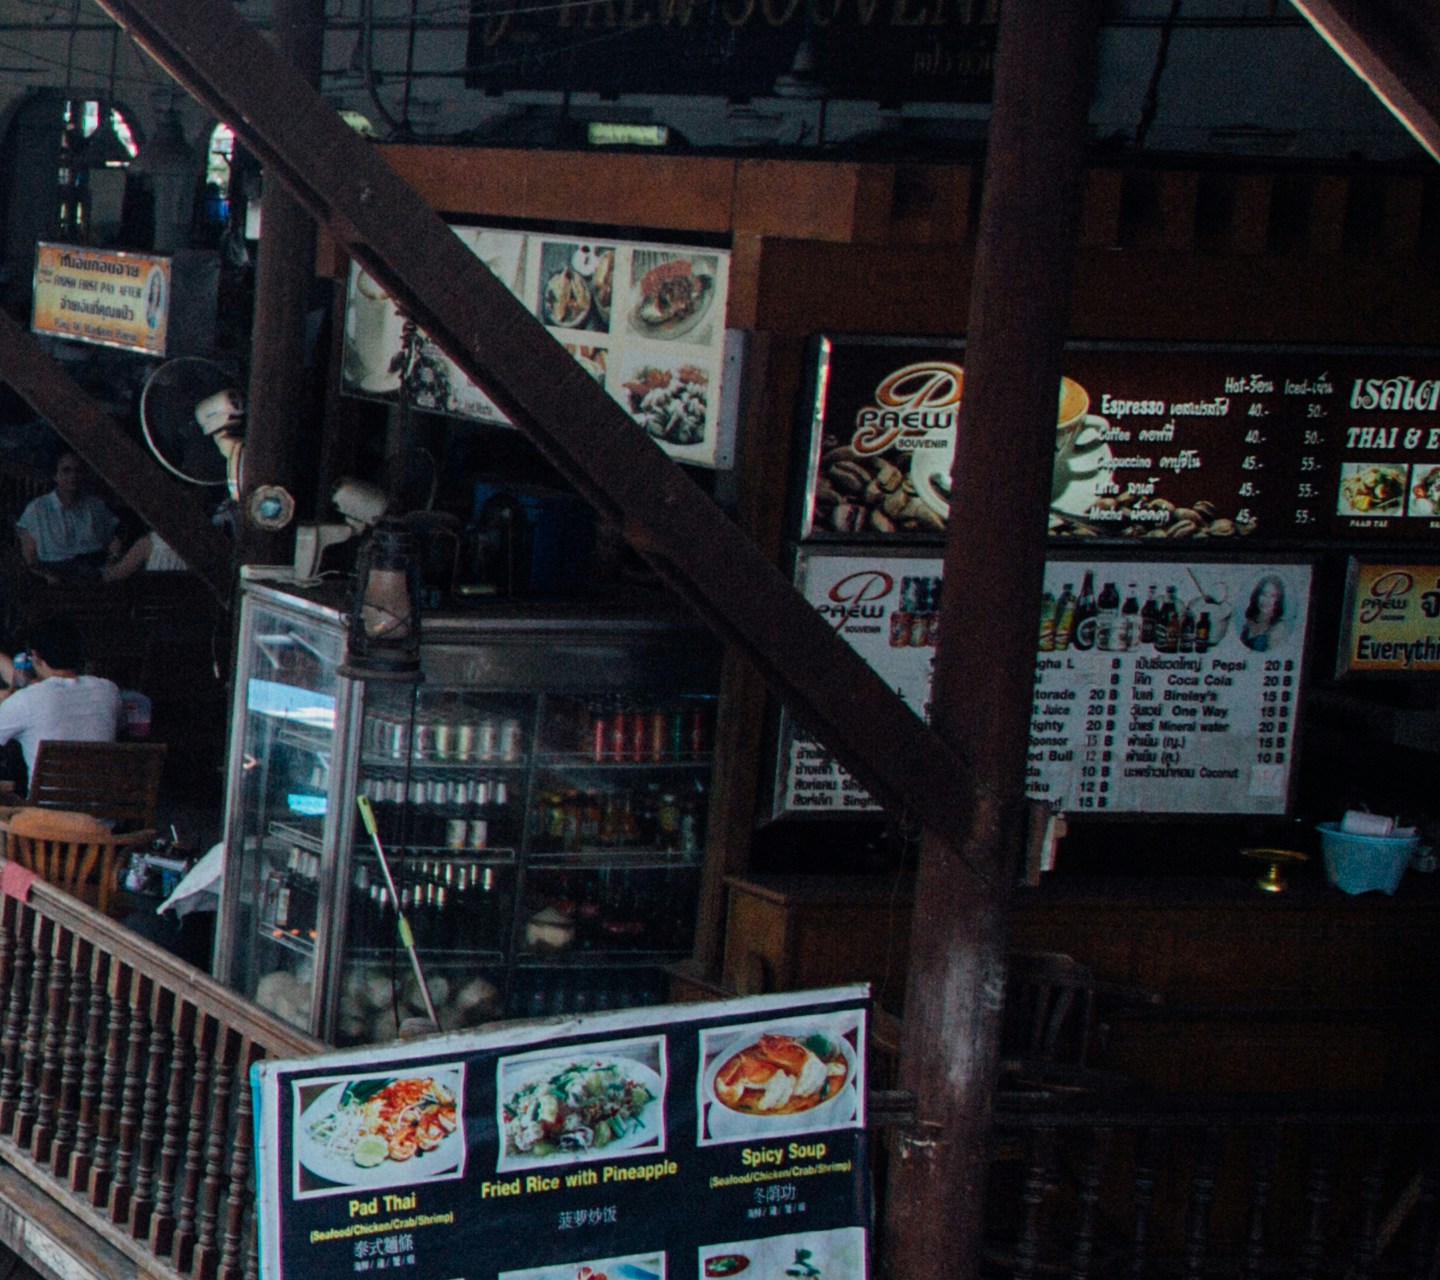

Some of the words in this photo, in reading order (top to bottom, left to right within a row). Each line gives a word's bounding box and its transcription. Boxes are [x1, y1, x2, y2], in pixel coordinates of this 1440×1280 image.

[1101, 394, 1166, 418] Espresso
[858, 410, 953, 429] PAEW
[897, 438, 949, 449] SOUVENIR
[1346, 426, 1399, 450] THAI
[1403, 426, 1423, 450] &
[1033, 659, 1062, 671] gha
[1212, 659, 1247, 673] Pepsi
[1264, 660, 1280, 671] 20
[1167, 675, 1199, 687] Coca
[1204, 675, 1233, 687] Cola
[1263, 675, 1278, 687] 20
[1089, 689, 1105, 701] 20
[1042, 705, 1070, 717] Juice
[1087, 705, 1103, 716] 20
[1171, 705, 1198, 717] One
[1202, 705, 1228, 719] Way
[1085, 720, 1102, 732] 20
[1258, 721, 1274, 733] 20
[1048, 750, 1073, 762] Bull
[741, 1145, 784, 1168] Spicy
[788, 1142, 827, 1159] Soup
[481, 1177, 522, 1200] Fried
[526, 1174, 561, 1195] Rice
[565, 1169, 598, 1189] with
[603, 1158, 679, 1184] Pineapple
[348, 1196, 379, 1219] Pad
[383, 1191, 418, 1213] Thai
